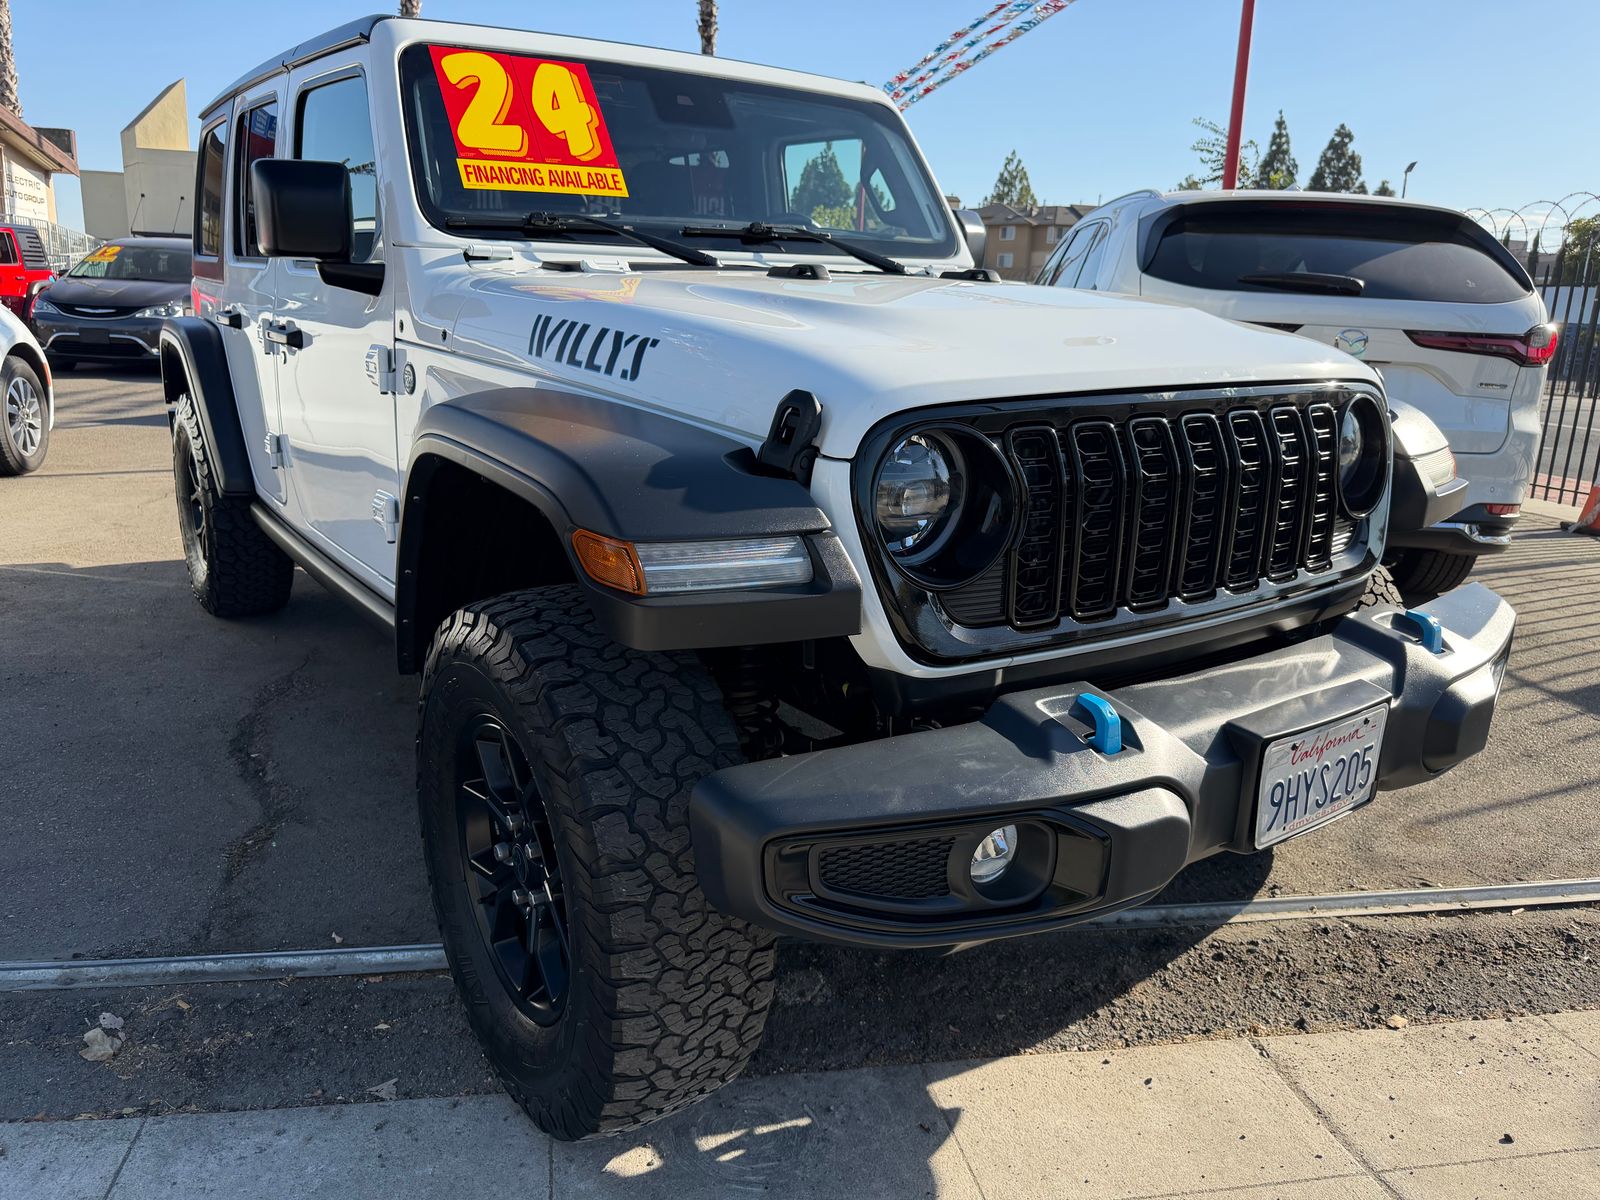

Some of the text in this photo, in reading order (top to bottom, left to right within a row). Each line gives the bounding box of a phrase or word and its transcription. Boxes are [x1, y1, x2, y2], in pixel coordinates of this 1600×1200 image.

[441, 52, 603, 161] 24
[463, 164, 623, 191] FINANCING AVAILABLE
[24, 193, 45, 204] GROUP
[528, 314, 660, 381] WILLYS
[1291, 727, 1365, 765] California
[1267, 744, 1374, 832] 9HYS205
[1288, 799, 1349, 831] dmv.ca.gov
